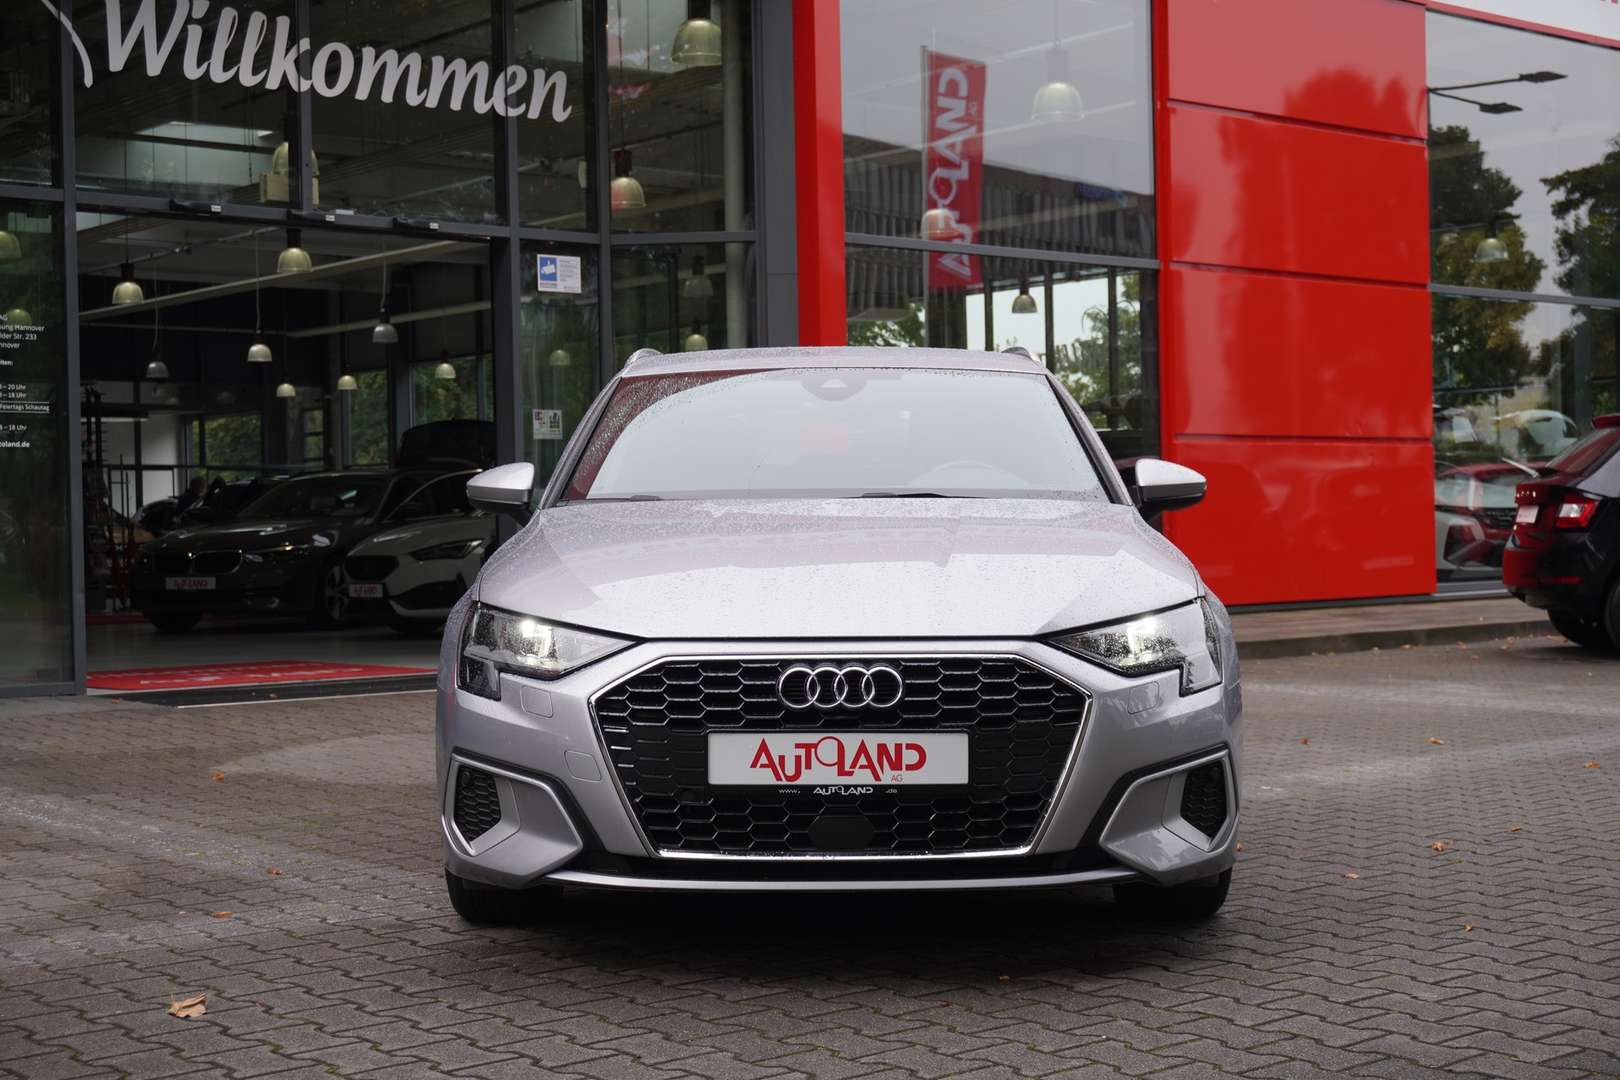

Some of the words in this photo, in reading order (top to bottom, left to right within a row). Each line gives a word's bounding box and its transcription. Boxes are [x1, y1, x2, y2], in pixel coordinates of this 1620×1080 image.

[104, 0, 573, 123] Willkommen
[750, 736, 927, 782] AUTOLAND
[813, 786, 873, 795] AUTOLAND
[890, 774, 904, 782] AG
